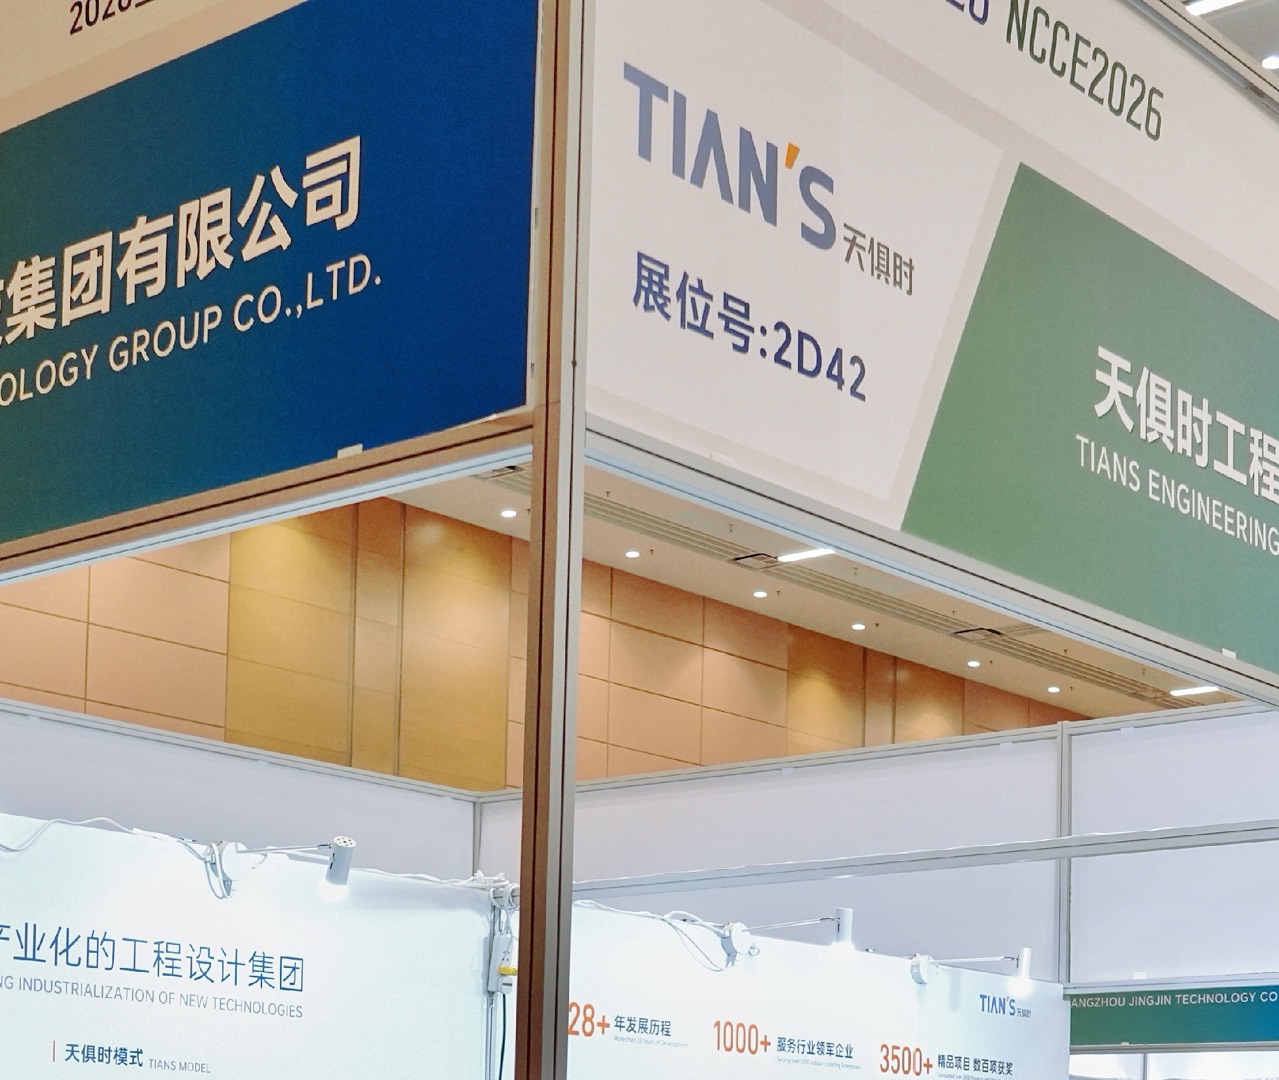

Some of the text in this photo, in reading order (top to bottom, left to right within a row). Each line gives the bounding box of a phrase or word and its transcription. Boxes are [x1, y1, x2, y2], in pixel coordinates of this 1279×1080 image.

[1006, 0, 1164, 141] NCCE2026
[623, 60, 915, 297] TIAN'S 天俱时
[108, 303, 223, 372] GROUP
[232, 252, 382, 333] CO.,LTD.
[632, 250, 867, 403] 展位号:2D42
[1075, 433, 1141, 493] TIANS
[18, 974, 155, 1005] INDUSTRIALIZATION
[158, 987, 176, 1004] OF
[178, 990, 208, 1010] NEW
[211, 995, 304, 1019] TECHNOLOGIES
[1128, 994, 1172, 1007] JINGJIN
[1175, 991, 1256, 1005] TECHNOLOGY
[614, 1014, 672, 1037] 年发展历程
[714, 1019, 854, 1060] 1000+ 服务行业领军企业
[64, 1042, 212, 1074] 天俱时模式 TIANS MODEL
[880, 1043, 1013, 1077] 3500+ 精品项目 数百项获奖
